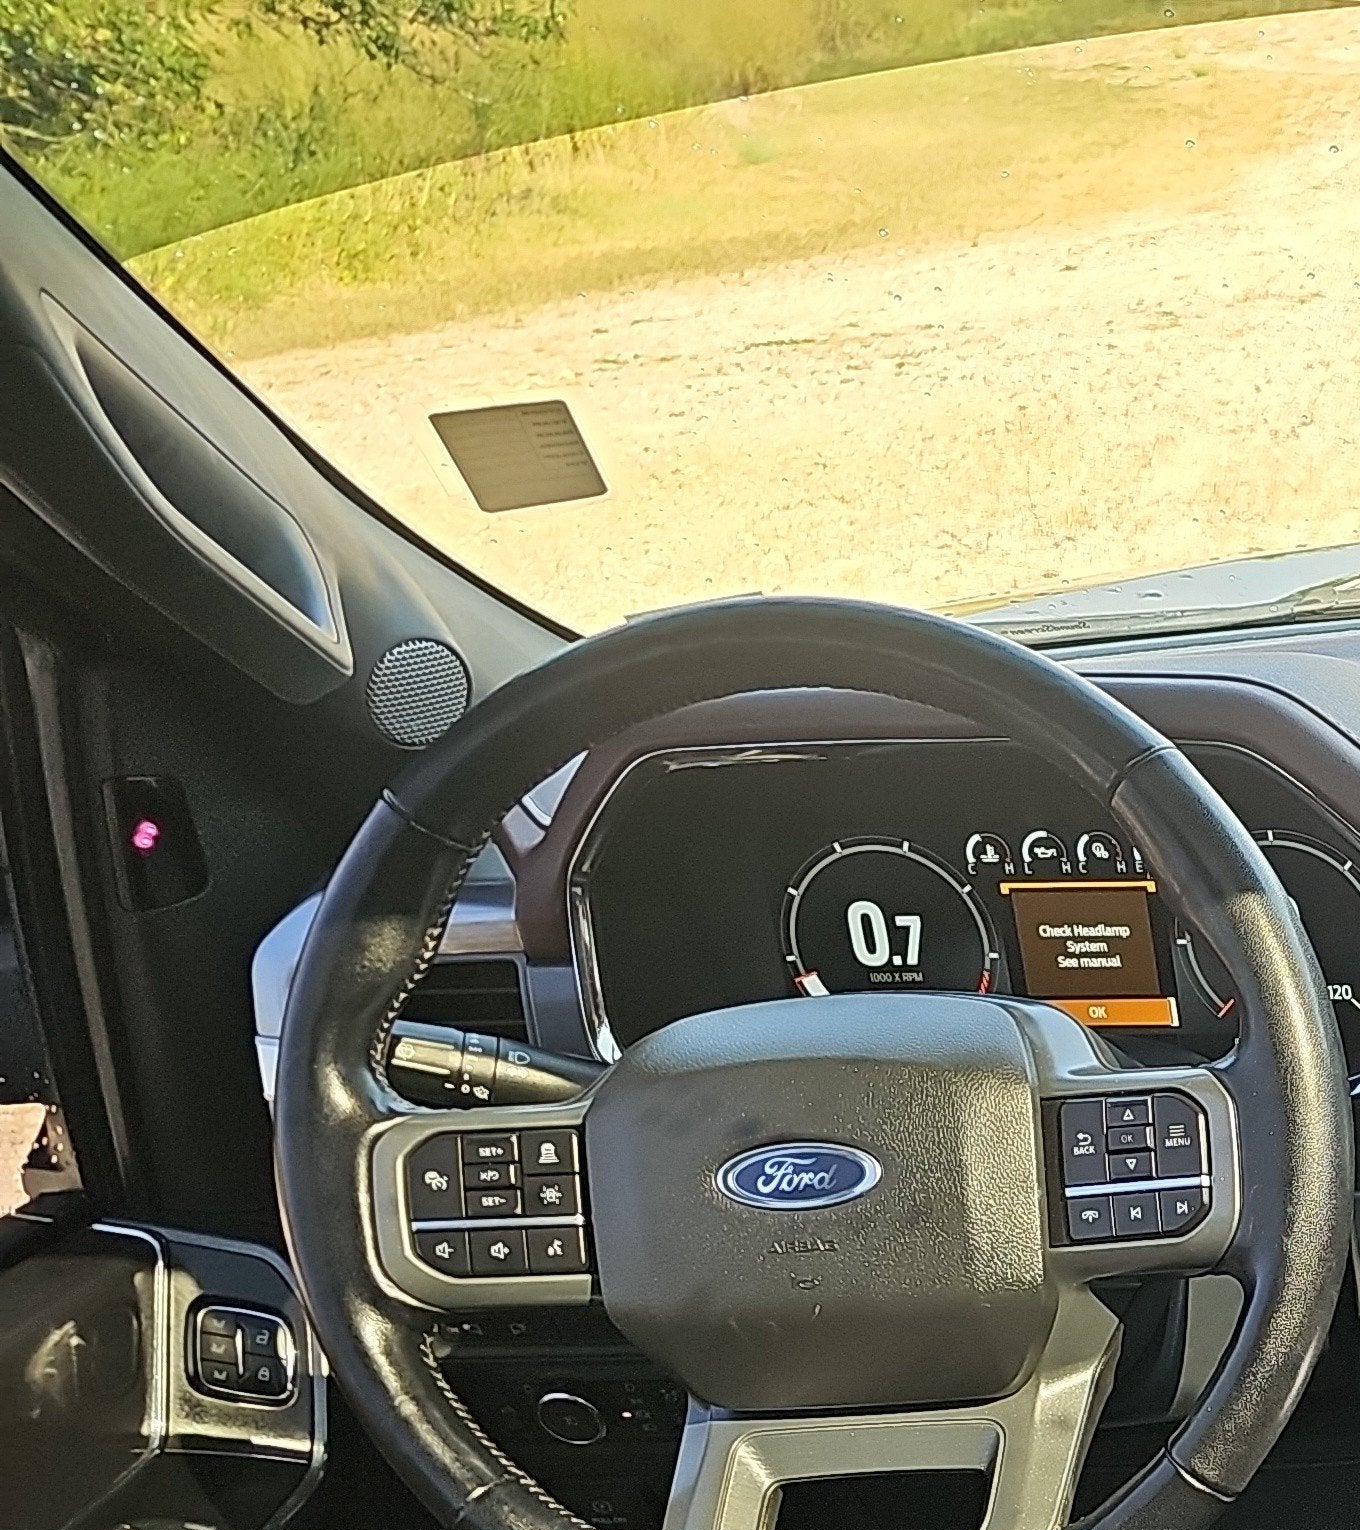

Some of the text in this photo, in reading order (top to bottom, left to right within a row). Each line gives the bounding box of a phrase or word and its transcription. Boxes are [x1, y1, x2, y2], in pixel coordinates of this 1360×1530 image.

[847, 900, 922, 967] 0.7
[1038, 924, 1130, 939] Check Headlamp
[1066, 940, 1108, 954] System
[1057, 955, 1122, 968] See manual
[869, 972, 893, 982] 1000
[902, 972, 924, 982] RPM
[1327, 985, 1352, 1000] 120
[1088, 1006, 1107, 1018] OK
[1121, 1134, 1133, 1143] OK
[1165, 1137, 1191, 1147] MENU
[1073, 1146, 1095, 1155] BACK
[757, 1157, 837, 1194] Ford
